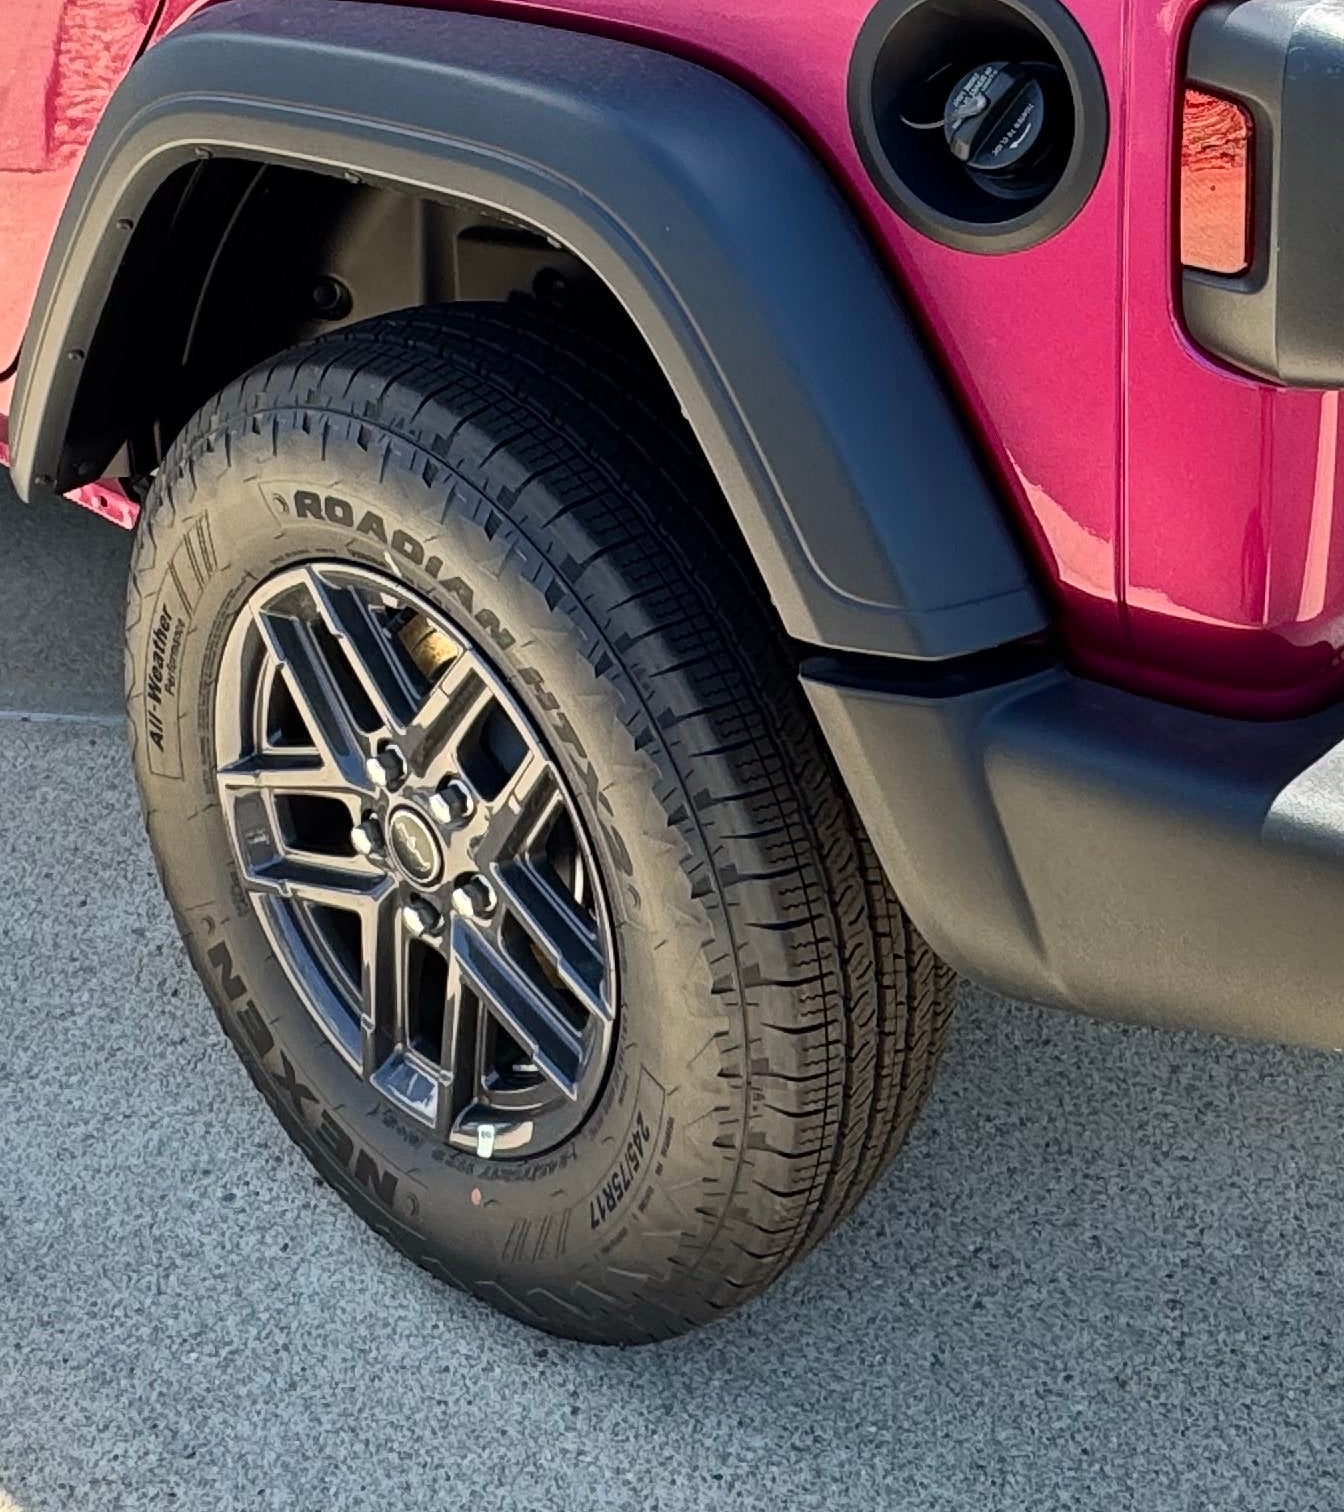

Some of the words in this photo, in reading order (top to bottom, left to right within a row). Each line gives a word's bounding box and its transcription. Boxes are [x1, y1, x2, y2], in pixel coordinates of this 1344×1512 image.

[293, 490, 516, 652] ROADIAN
[147, 603, 174, 753] All-Weather
[163, 618, 186, 697] Performance
[208, 942, 399, 1209] NEXEN
[589, 1111, 651, 1230] 245/75R17
